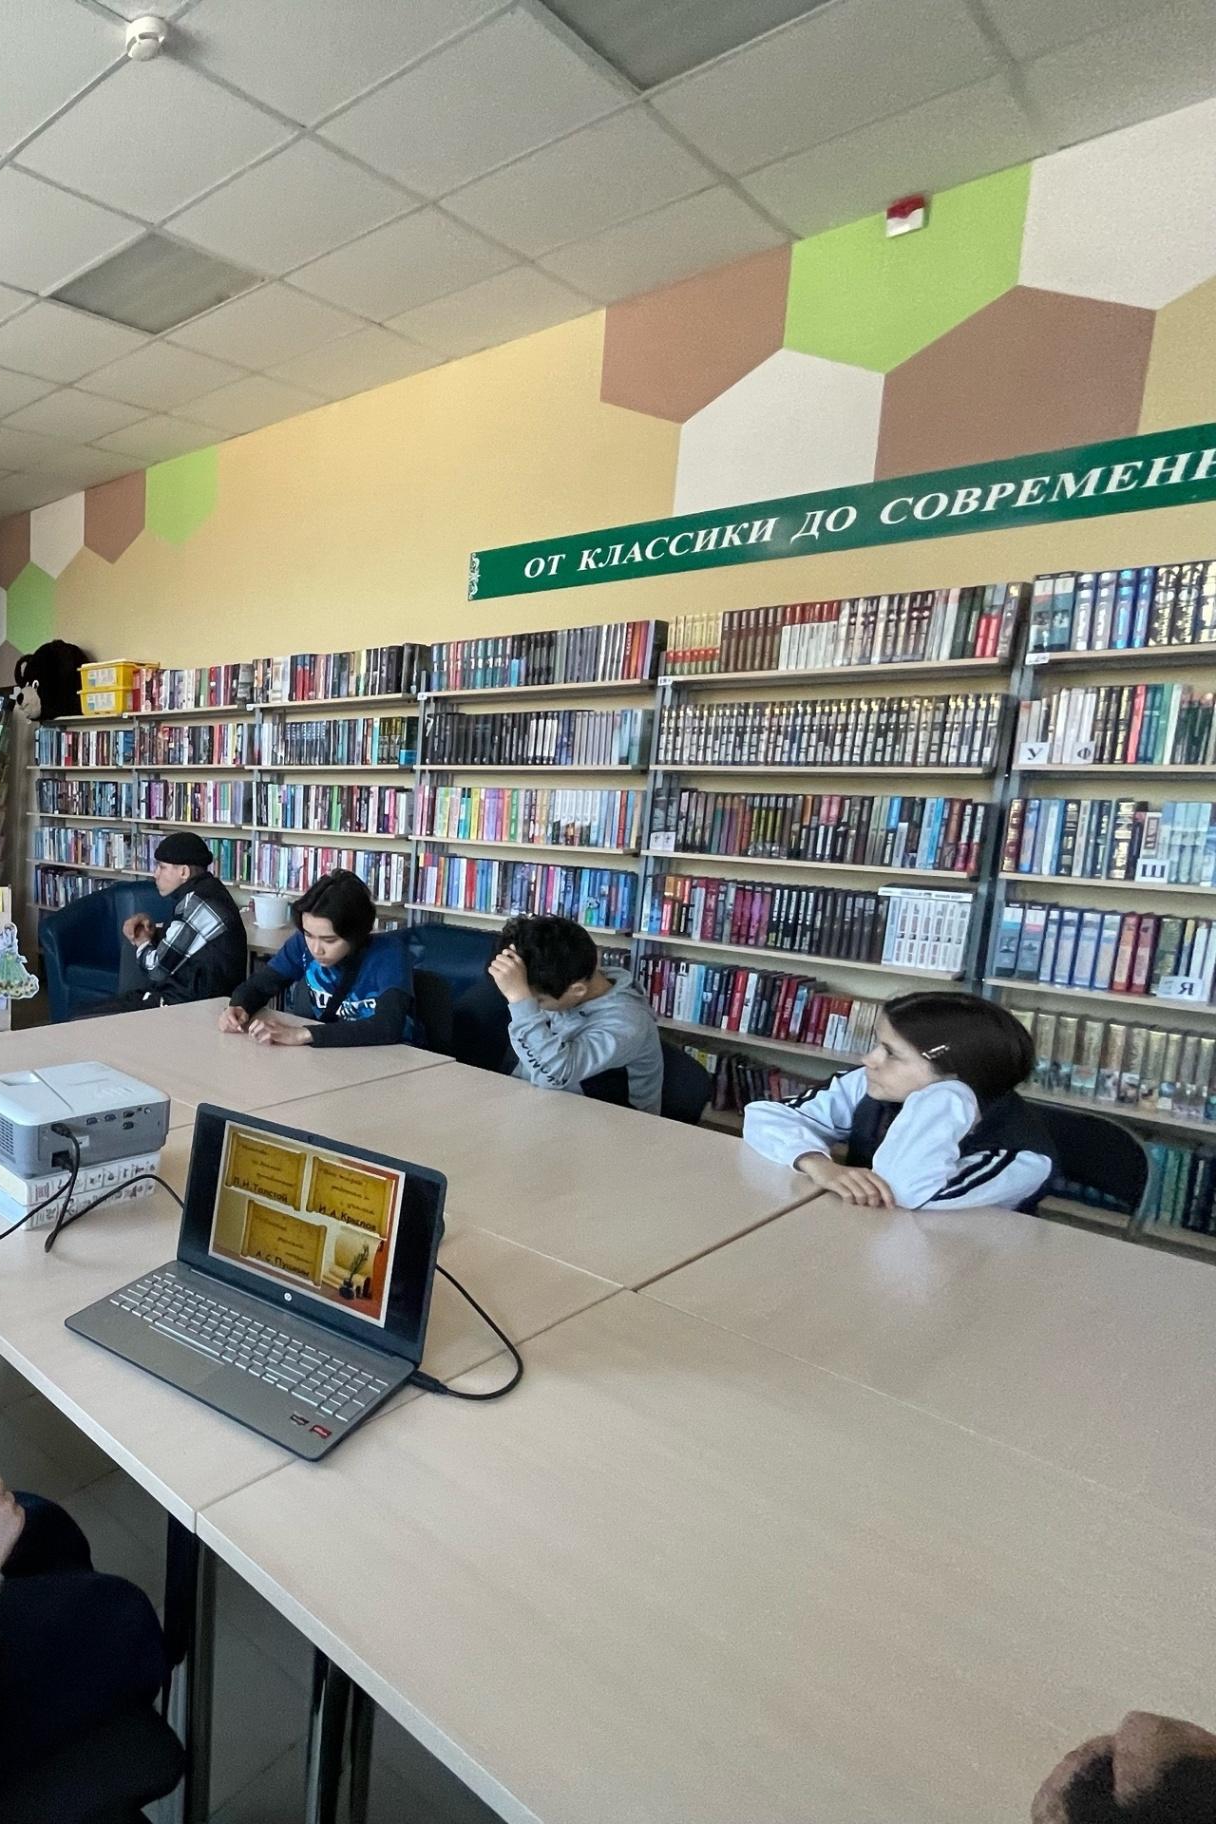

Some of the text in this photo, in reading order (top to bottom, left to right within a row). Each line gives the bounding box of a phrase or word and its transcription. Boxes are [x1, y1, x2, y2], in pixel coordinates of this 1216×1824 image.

[523, 554, 565, 578] ОТ
[576, 517, 781, 571] КЛАССИКИ
[790, 504, 858, 543] ДО
